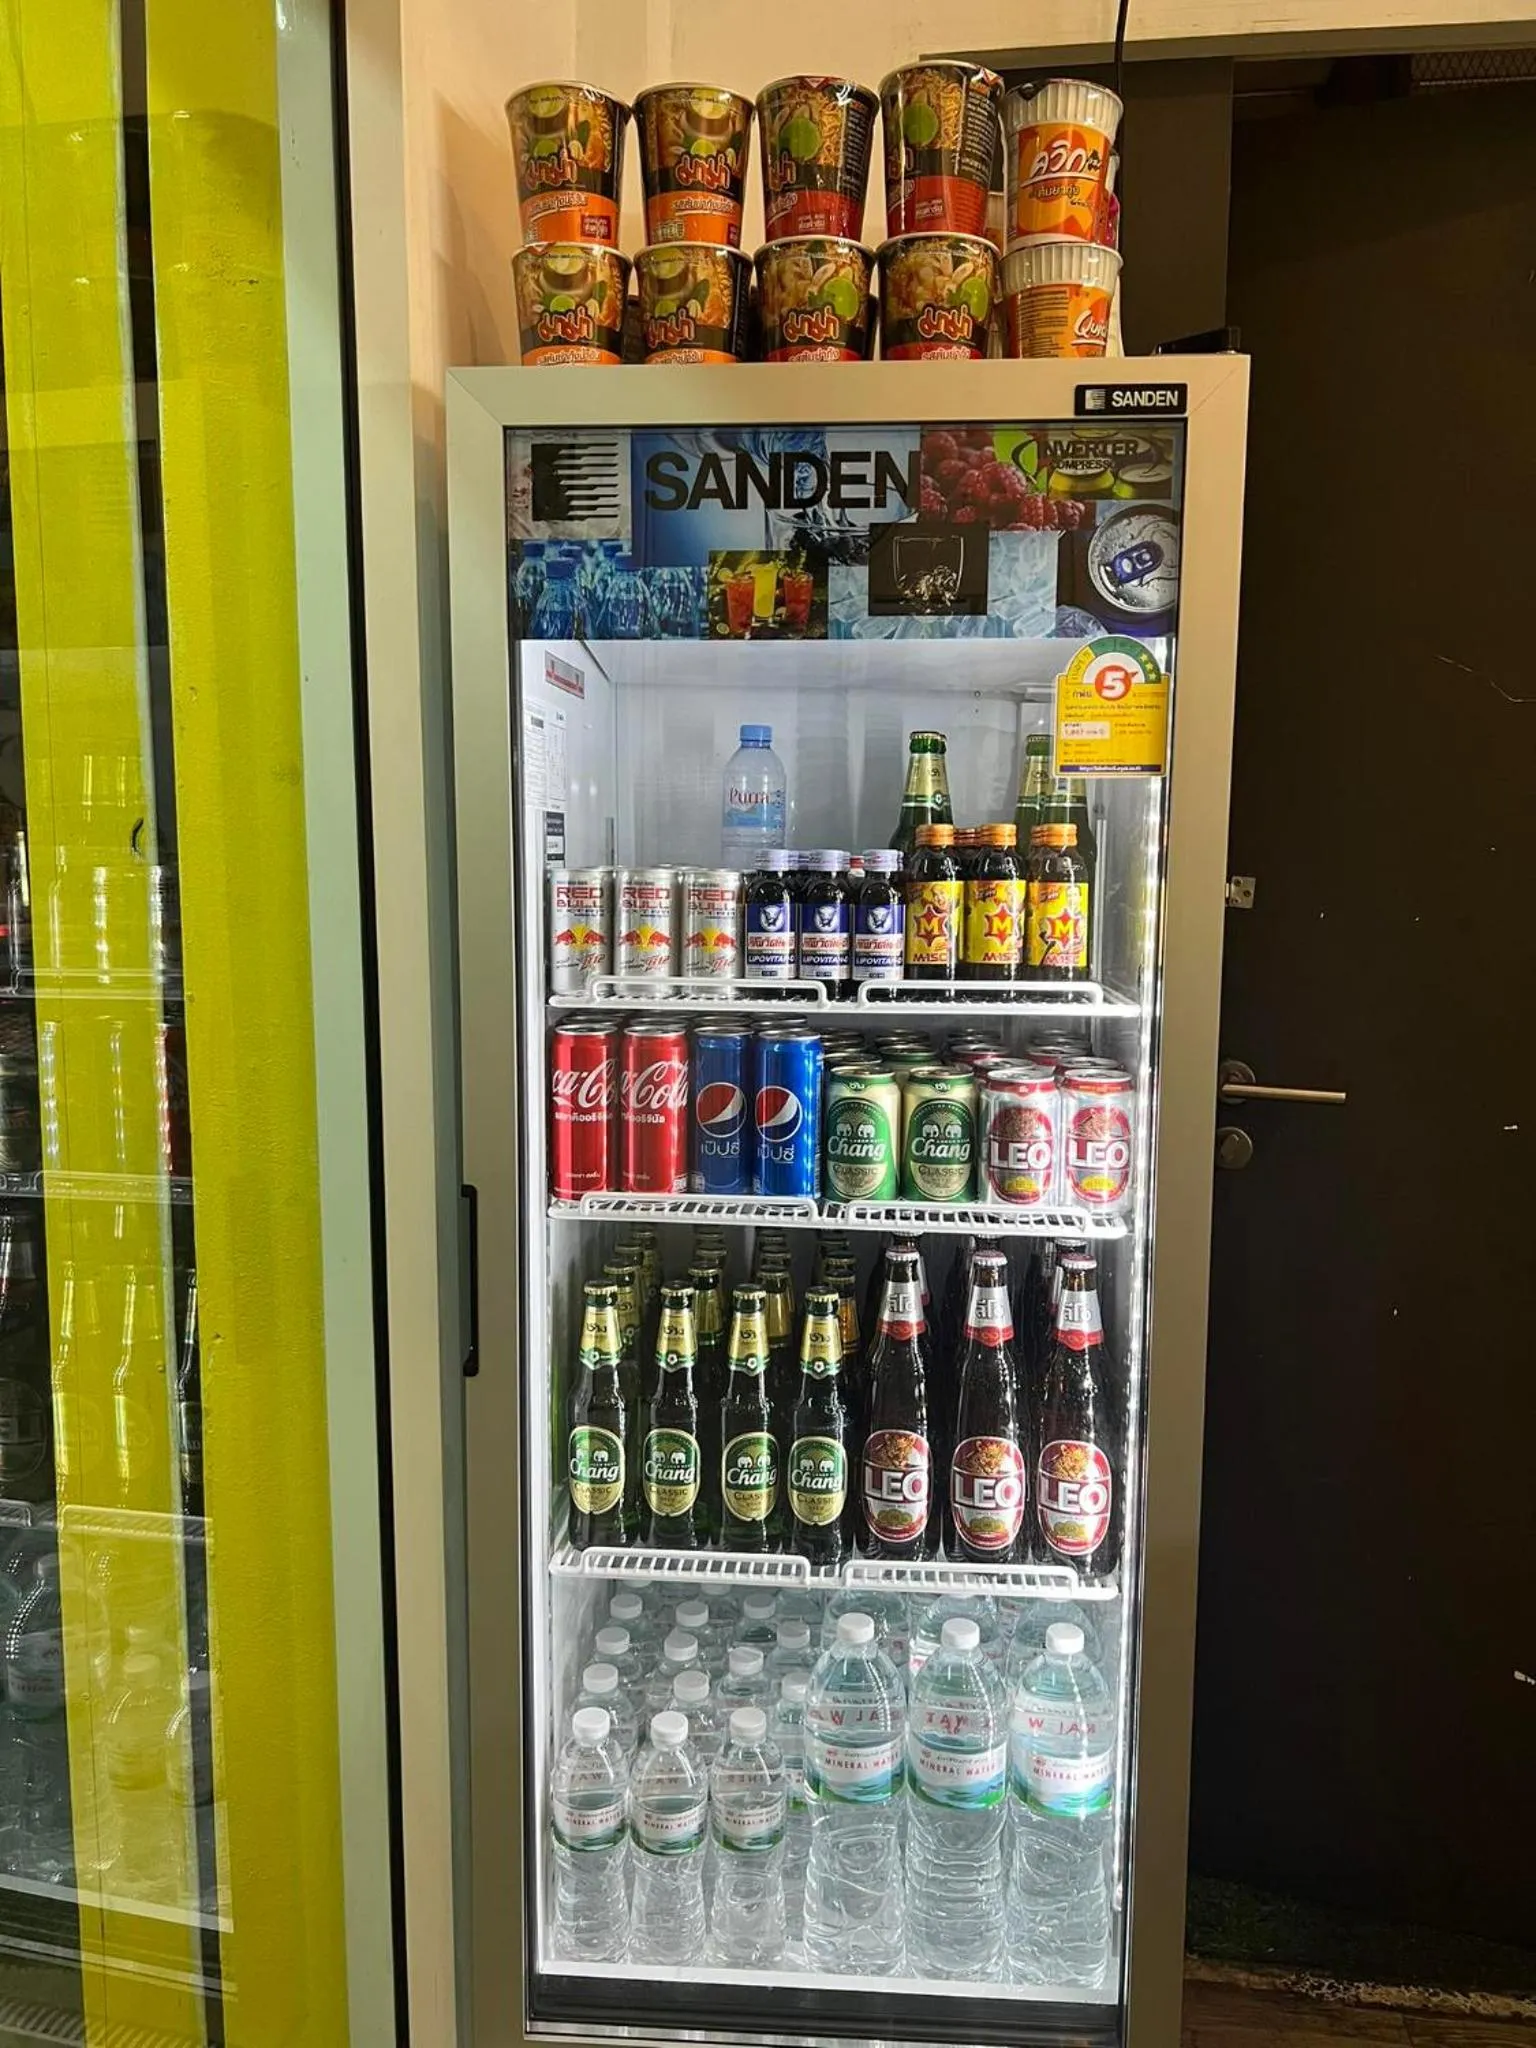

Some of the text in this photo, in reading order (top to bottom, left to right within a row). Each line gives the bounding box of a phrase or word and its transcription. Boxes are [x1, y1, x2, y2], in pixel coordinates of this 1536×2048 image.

[1111, 390, 1179, 408] SANDEN
[1045, 440, 1139, 458] NVERTER
[644, 450, 922, 512] SANDEN
[1101, 669, 1127, 698] 5
[556, 887, 603, 899] RED
[622, 887, 669, 899] RED
[688, 889, 736, 901] RED
[828, 1136, 887, 1161] Chang
[911, 1137, 971, 1161] Chang
[990, 1140, 1052, 1170] LEO
[1068, 1140, 1130, 1169] LEO
[570, 1458, 620, 1481] Chang
[645, 1460, 696, 1483] Chang
[727, 1467, 777, 1486] Chang
[791, 1469, 843, 1492] Chang
[864, 1465, 928, 1502] LEO
[955, 1472, 1021, 1509] LEO
[1041, 1474, 1108, 1514] LEO
[825, 1758, 869, 1769] MINERAL
[919, 1758, 961, 1776] MINERAL
